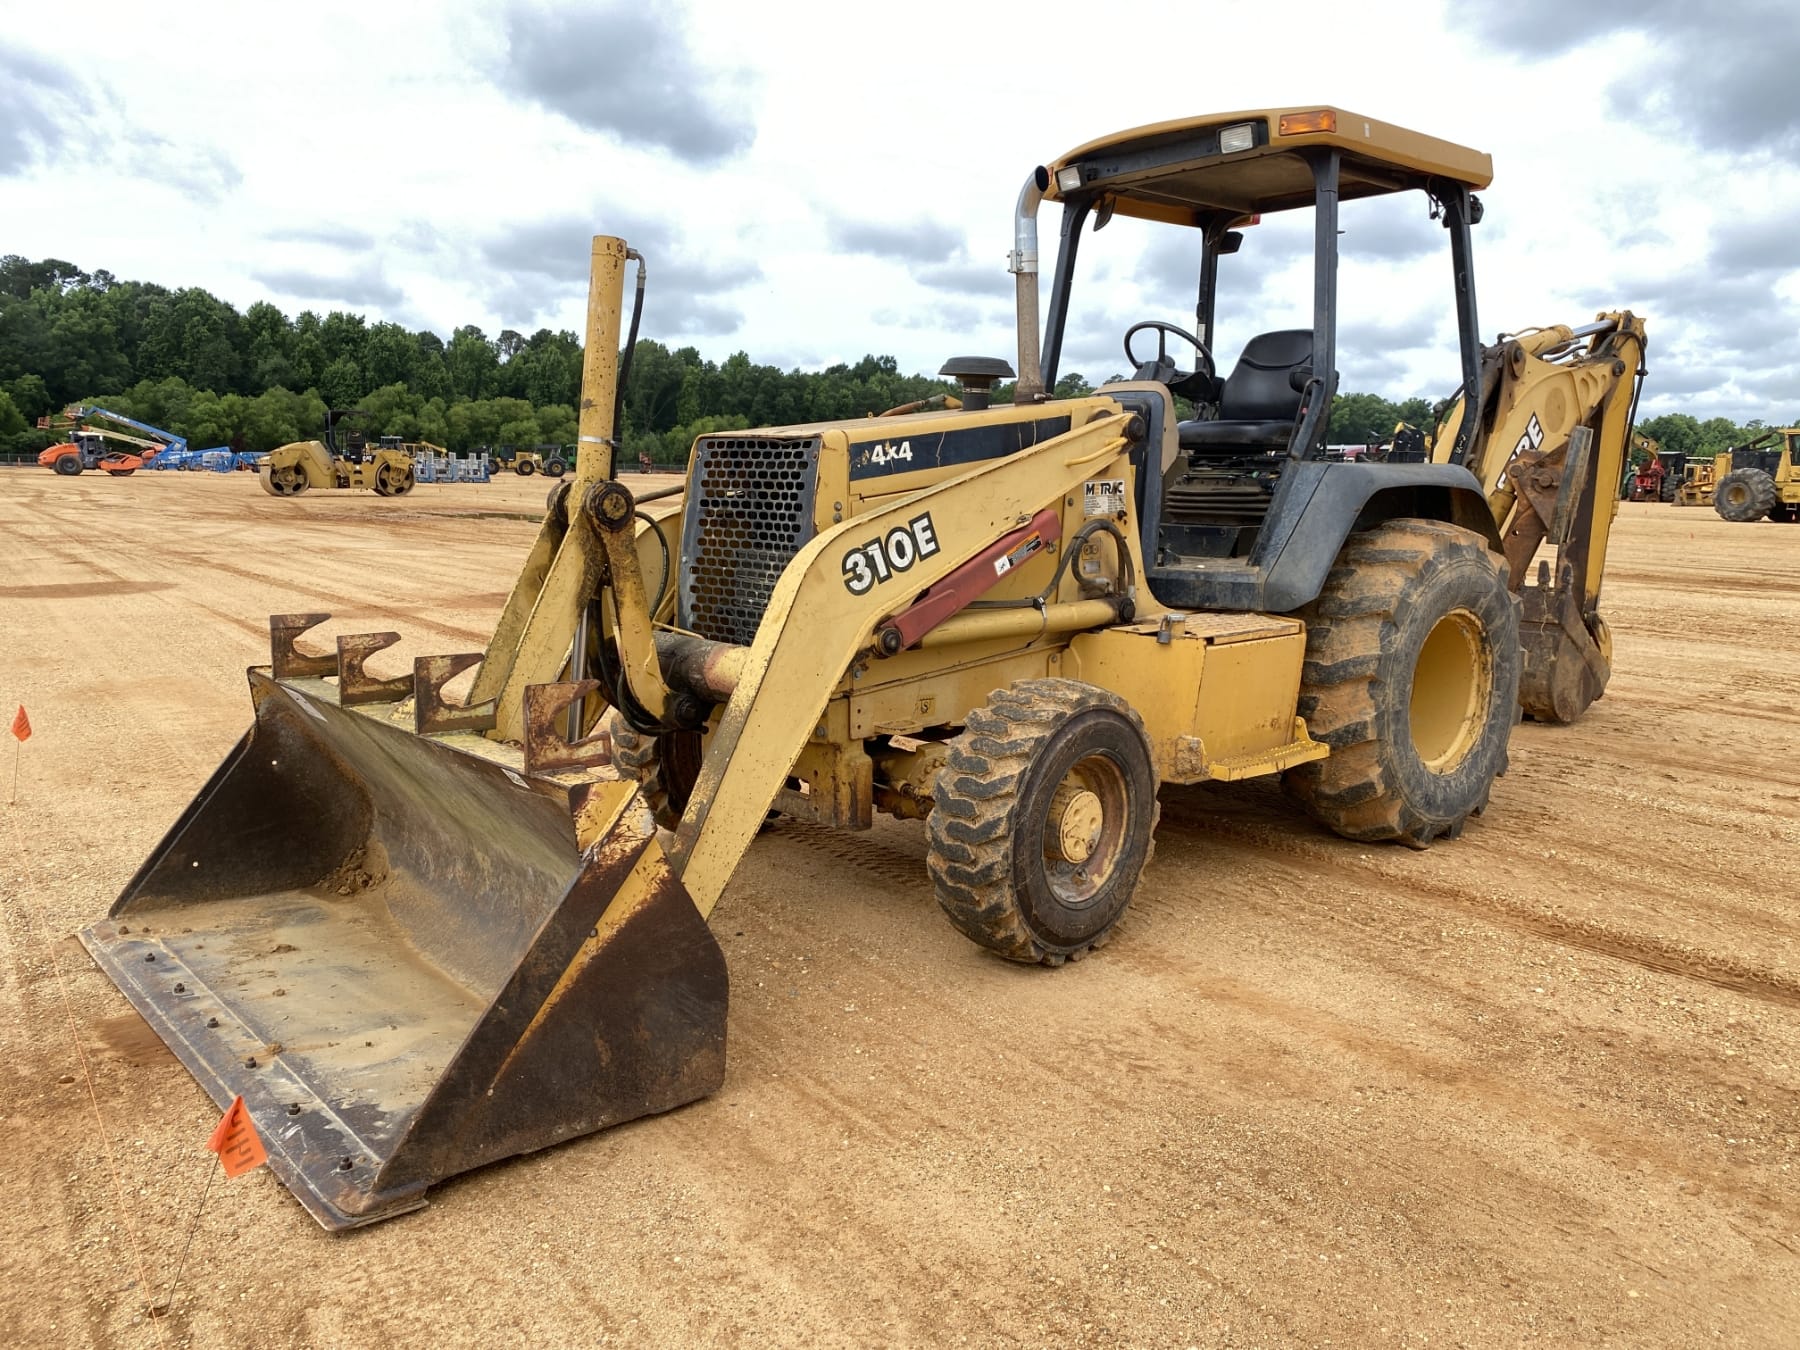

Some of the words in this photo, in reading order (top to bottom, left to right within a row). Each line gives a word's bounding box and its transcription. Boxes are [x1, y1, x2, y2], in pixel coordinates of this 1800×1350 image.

[871, 441, 913, 465] 4x4
[1085, 482, 1123, 496] MTRAC
[842, 510, 941, 596] 310E
